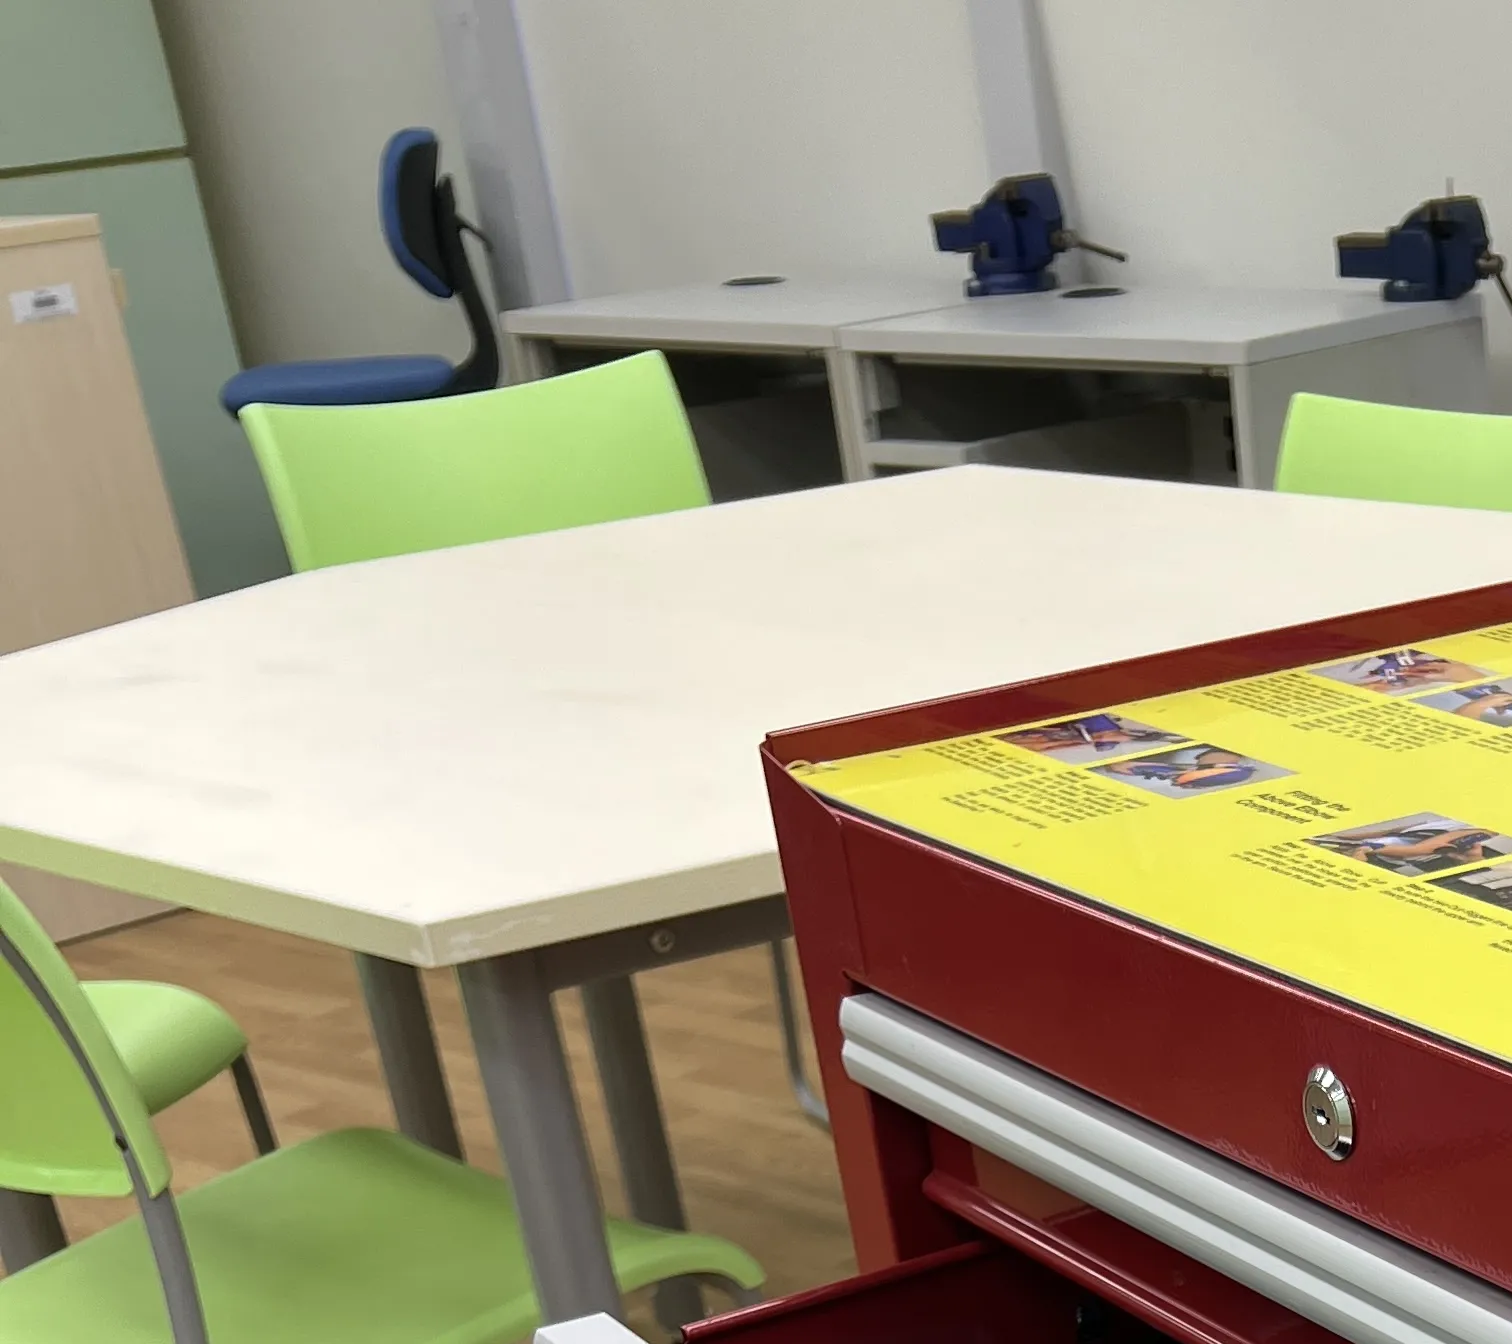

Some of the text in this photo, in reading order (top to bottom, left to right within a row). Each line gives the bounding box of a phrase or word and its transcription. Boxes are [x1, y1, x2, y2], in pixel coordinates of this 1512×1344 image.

[1234, 798, 1313, 824] Component
[1253, 792, 1337, 820] Above Elbow
[1284, 789, 1351, 812] Fitting the
